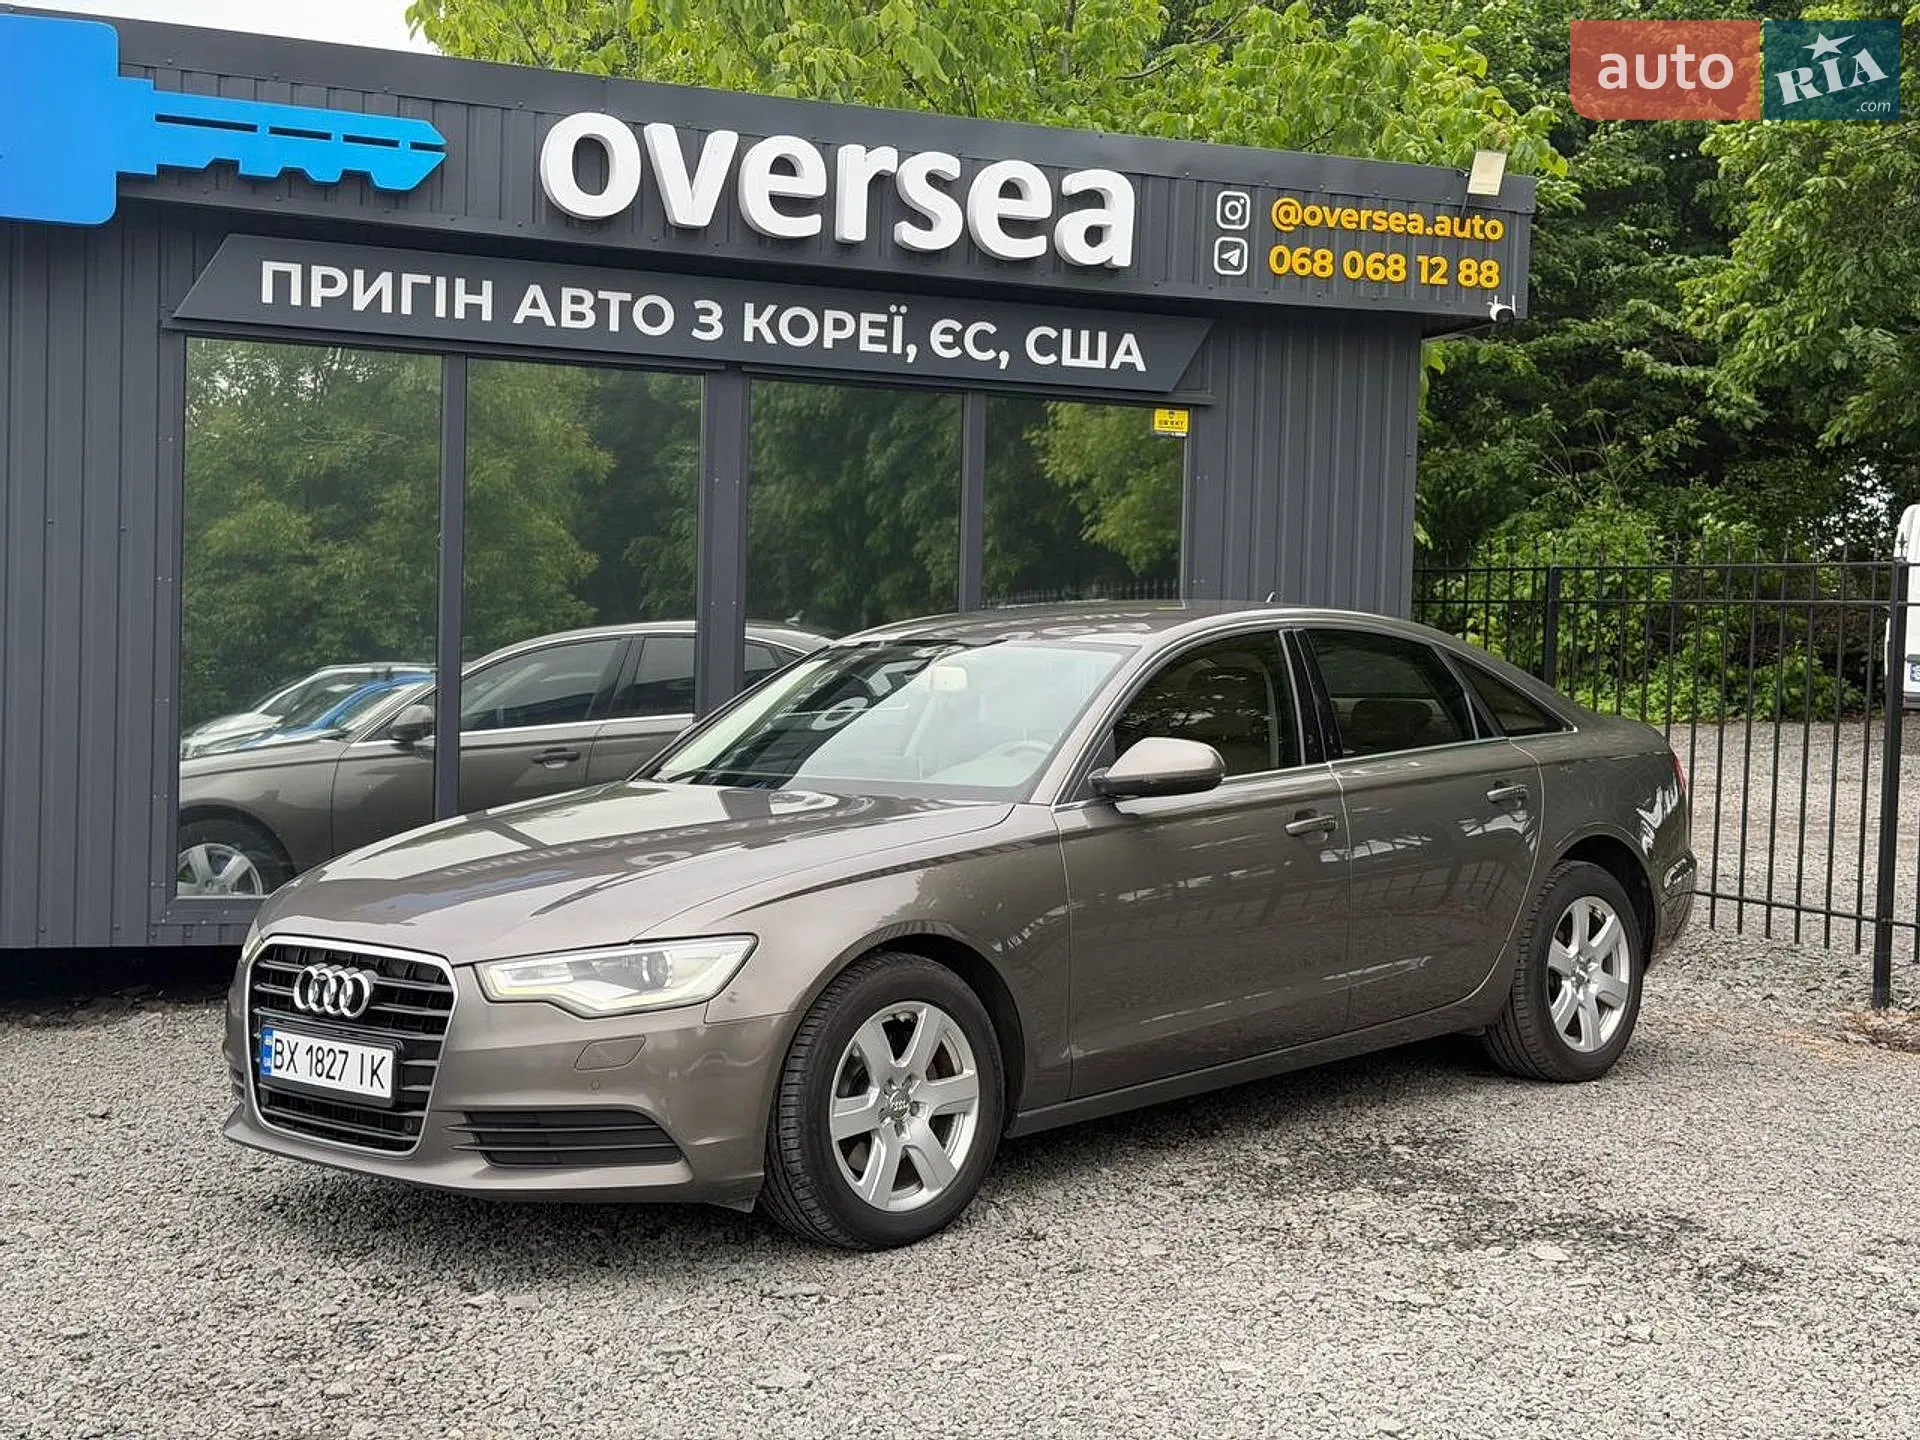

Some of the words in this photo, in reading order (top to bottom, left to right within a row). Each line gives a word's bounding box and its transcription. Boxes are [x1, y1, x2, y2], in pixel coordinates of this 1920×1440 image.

[540, 112, 1136, 269] oversea
[1271, 197, 1505, 240] @oversea.auto
[1269, 245, 1334, 278] 068
[1343, 250, 1407, 282] 068
[1416, 255, 1449, 285] 12
[1457, 259, 1500, 288] 88
[260, 260, 494, 322] ПРИГІН
[513, 283, 675, 337] АВТО
[692, 299, 723, 342] З
[743, 304, 917, 364] КОРЕЇ,
[929, 318, 1010, 371] ЄС,
[1025, 326, 1147, 373] США
[274, 1038, 299, 1074] BX
[306, 1044, 349, 1082] 1827
[360, 1052, 386, 1089] IK
